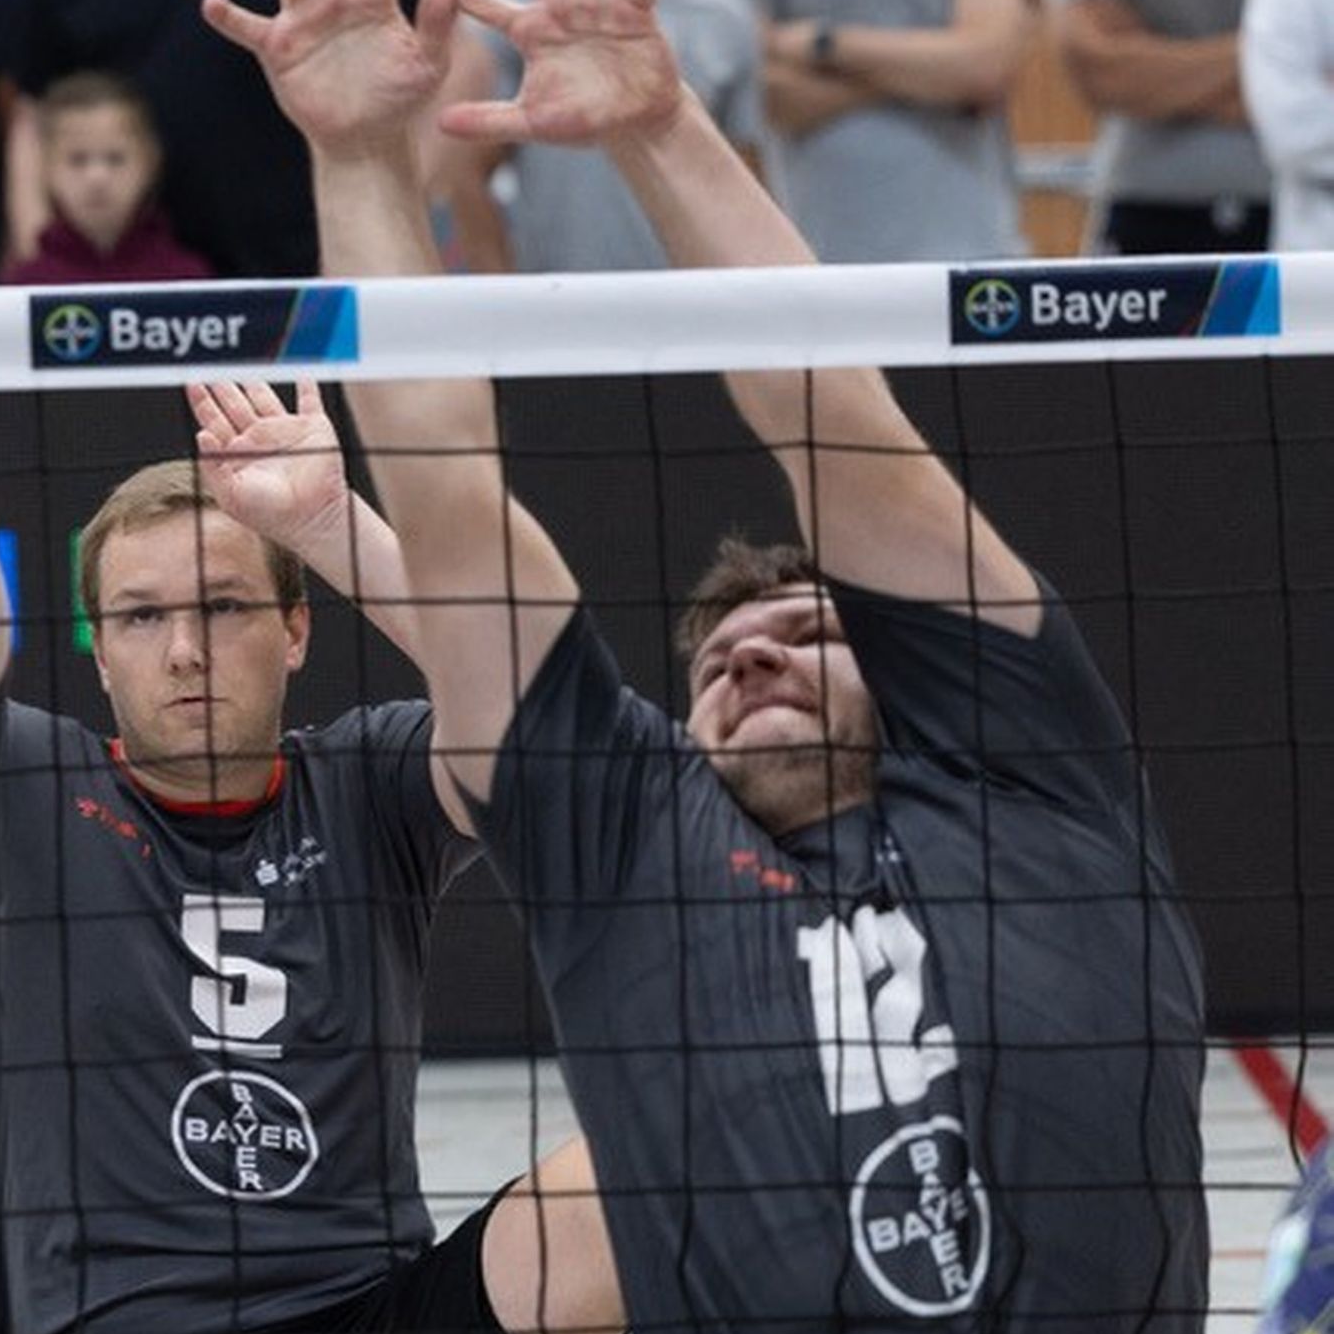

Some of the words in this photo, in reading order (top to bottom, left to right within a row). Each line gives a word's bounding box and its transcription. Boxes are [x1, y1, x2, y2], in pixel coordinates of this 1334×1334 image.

[110, 308, 246, 356] Bayer
[1031, 283, 1168, 331] Bayer
[181, 893, 286, 1040] 5
[797, 904, 959, 1117] 12
[184, 1117, 307, 1151] BAYER
[230, 1082, 263, 1191] BAYER
[868, 1188, 968, 1254] BAYE
[909, 1138, 969, 1299] BAYER
